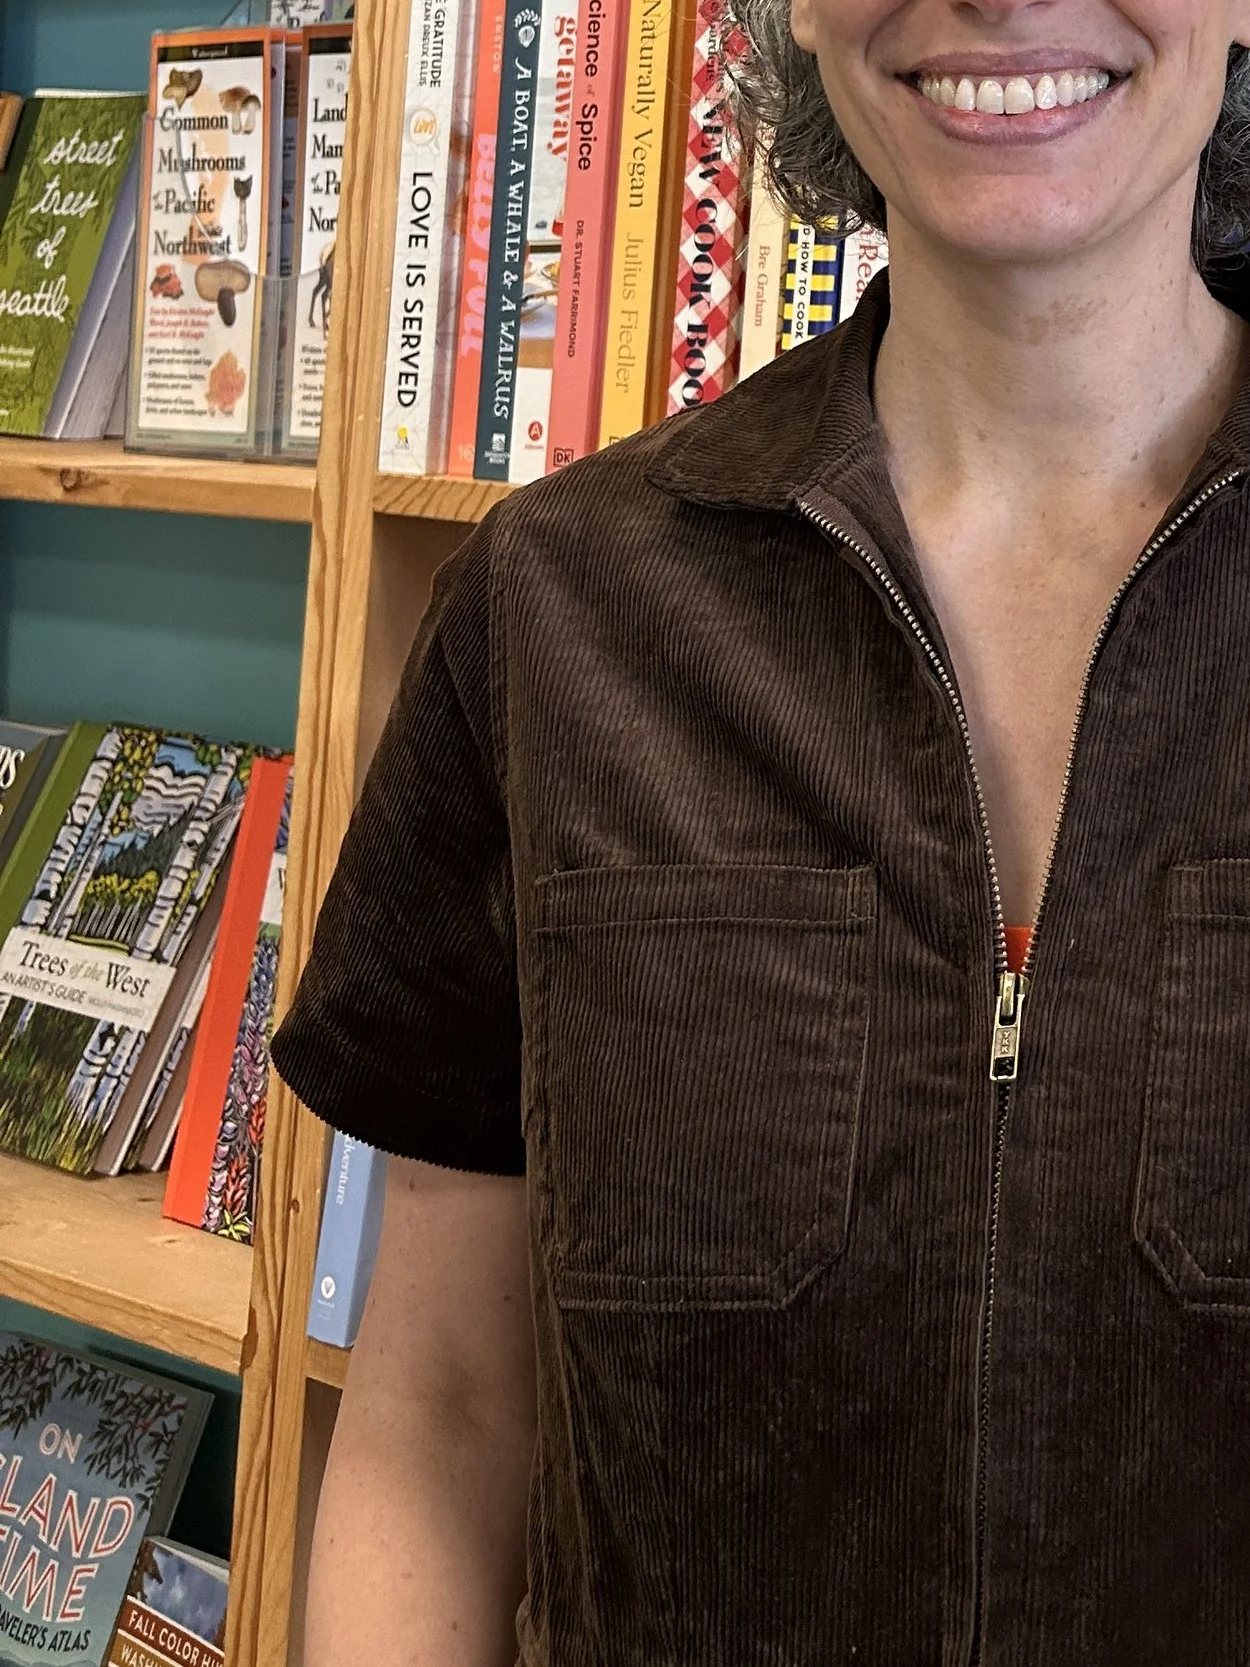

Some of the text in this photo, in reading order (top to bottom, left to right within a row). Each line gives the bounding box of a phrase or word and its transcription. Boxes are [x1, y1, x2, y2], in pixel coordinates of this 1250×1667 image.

[159, 106, 229, 133] Common
[44, 127, 123, 166] street
[158, 142, 246, 174] Mushrooms
[627, 128, 653, 209] Vegan
[30, 175, 98, 218] trees
[164, 183, 216, 215] Pacific
[36, 226, 66, 269] of
[153, 228, 233, 257] Northwest
[397, 172, 432, 408] LOVE IS SERVED
[20, 940, 151, 998] Trees of the West
[55, 985, 87, 1004] GUIDE
[39, 1422, 83, 1464] ON
[49, 1629, 91, 1654] ATLAS
[128, 1609, 200, 1667] FALL COLOR
